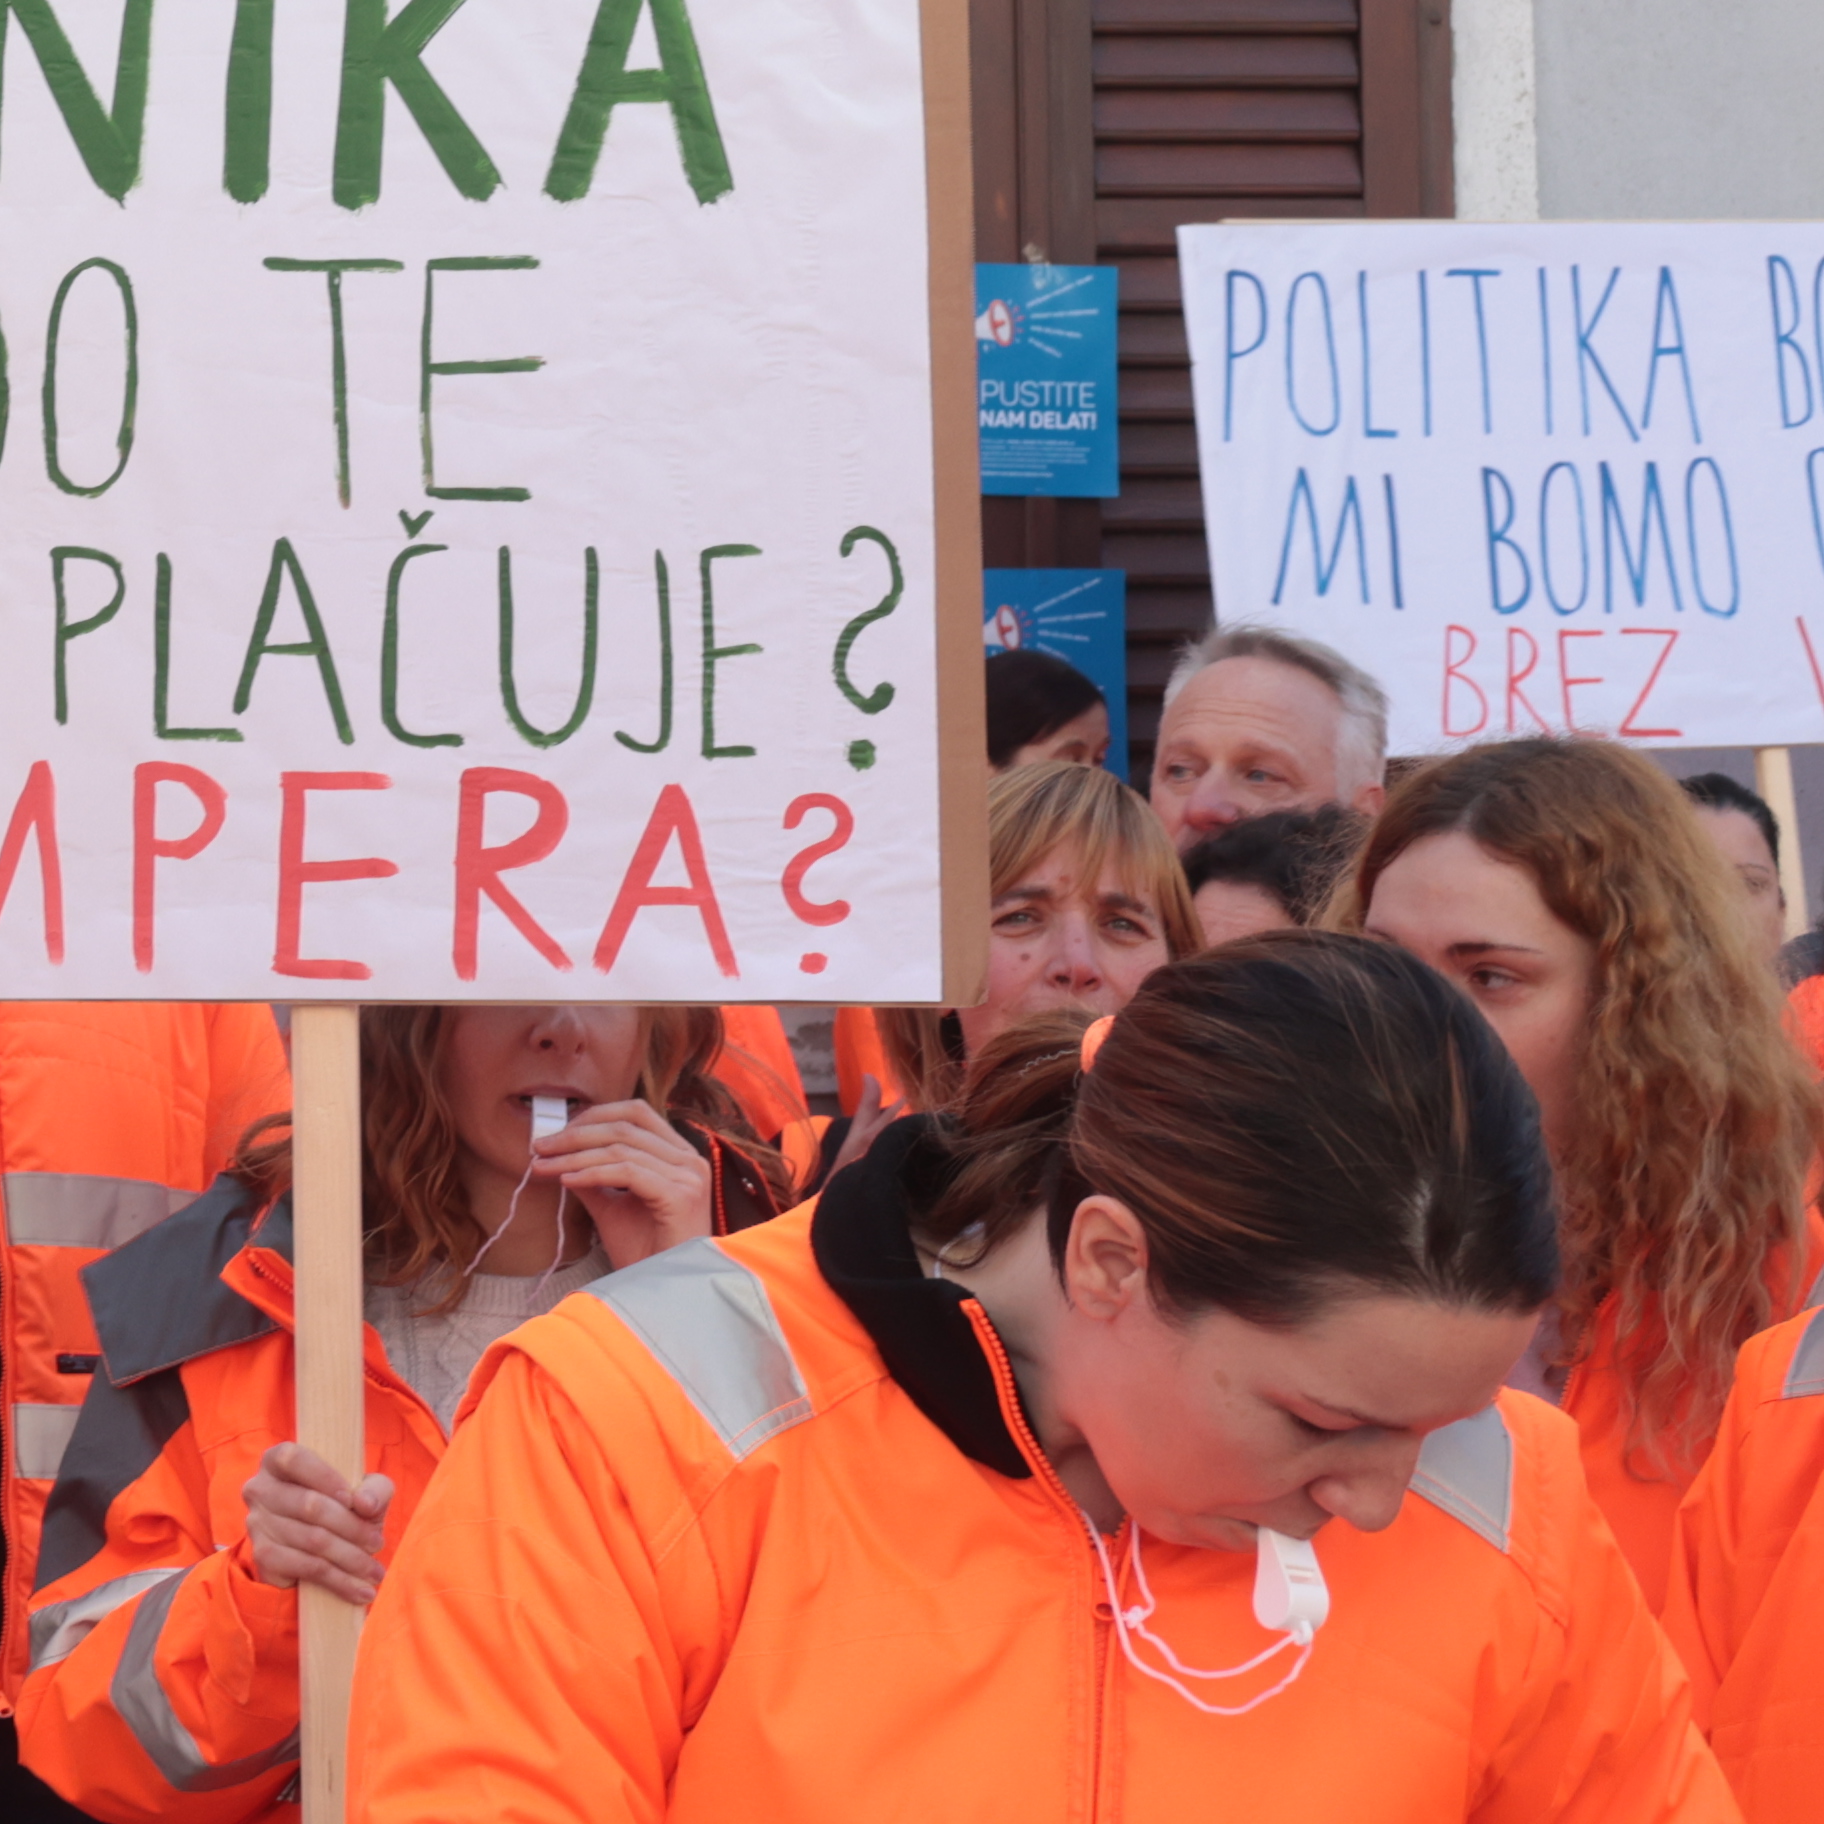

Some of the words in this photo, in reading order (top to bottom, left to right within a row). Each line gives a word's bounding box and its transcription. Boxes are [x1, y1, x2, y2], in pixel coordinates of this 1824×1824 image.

[263, 253, 547, 509] TE
[978, 409, 1026, 428] NAM
[1029, 410, 1097, 430] DELAT!
[979, 378, 1097, 409] PUSTITE
[1222, 262, 1702, 445] POLITIKA
[1271, 467, 1404, 610] MI
[1480, 457, 1741, 620] BOMO
[49, 510, 904, 771] PLAČUJE?
[1442, 623, 1684, 739] BREZ
